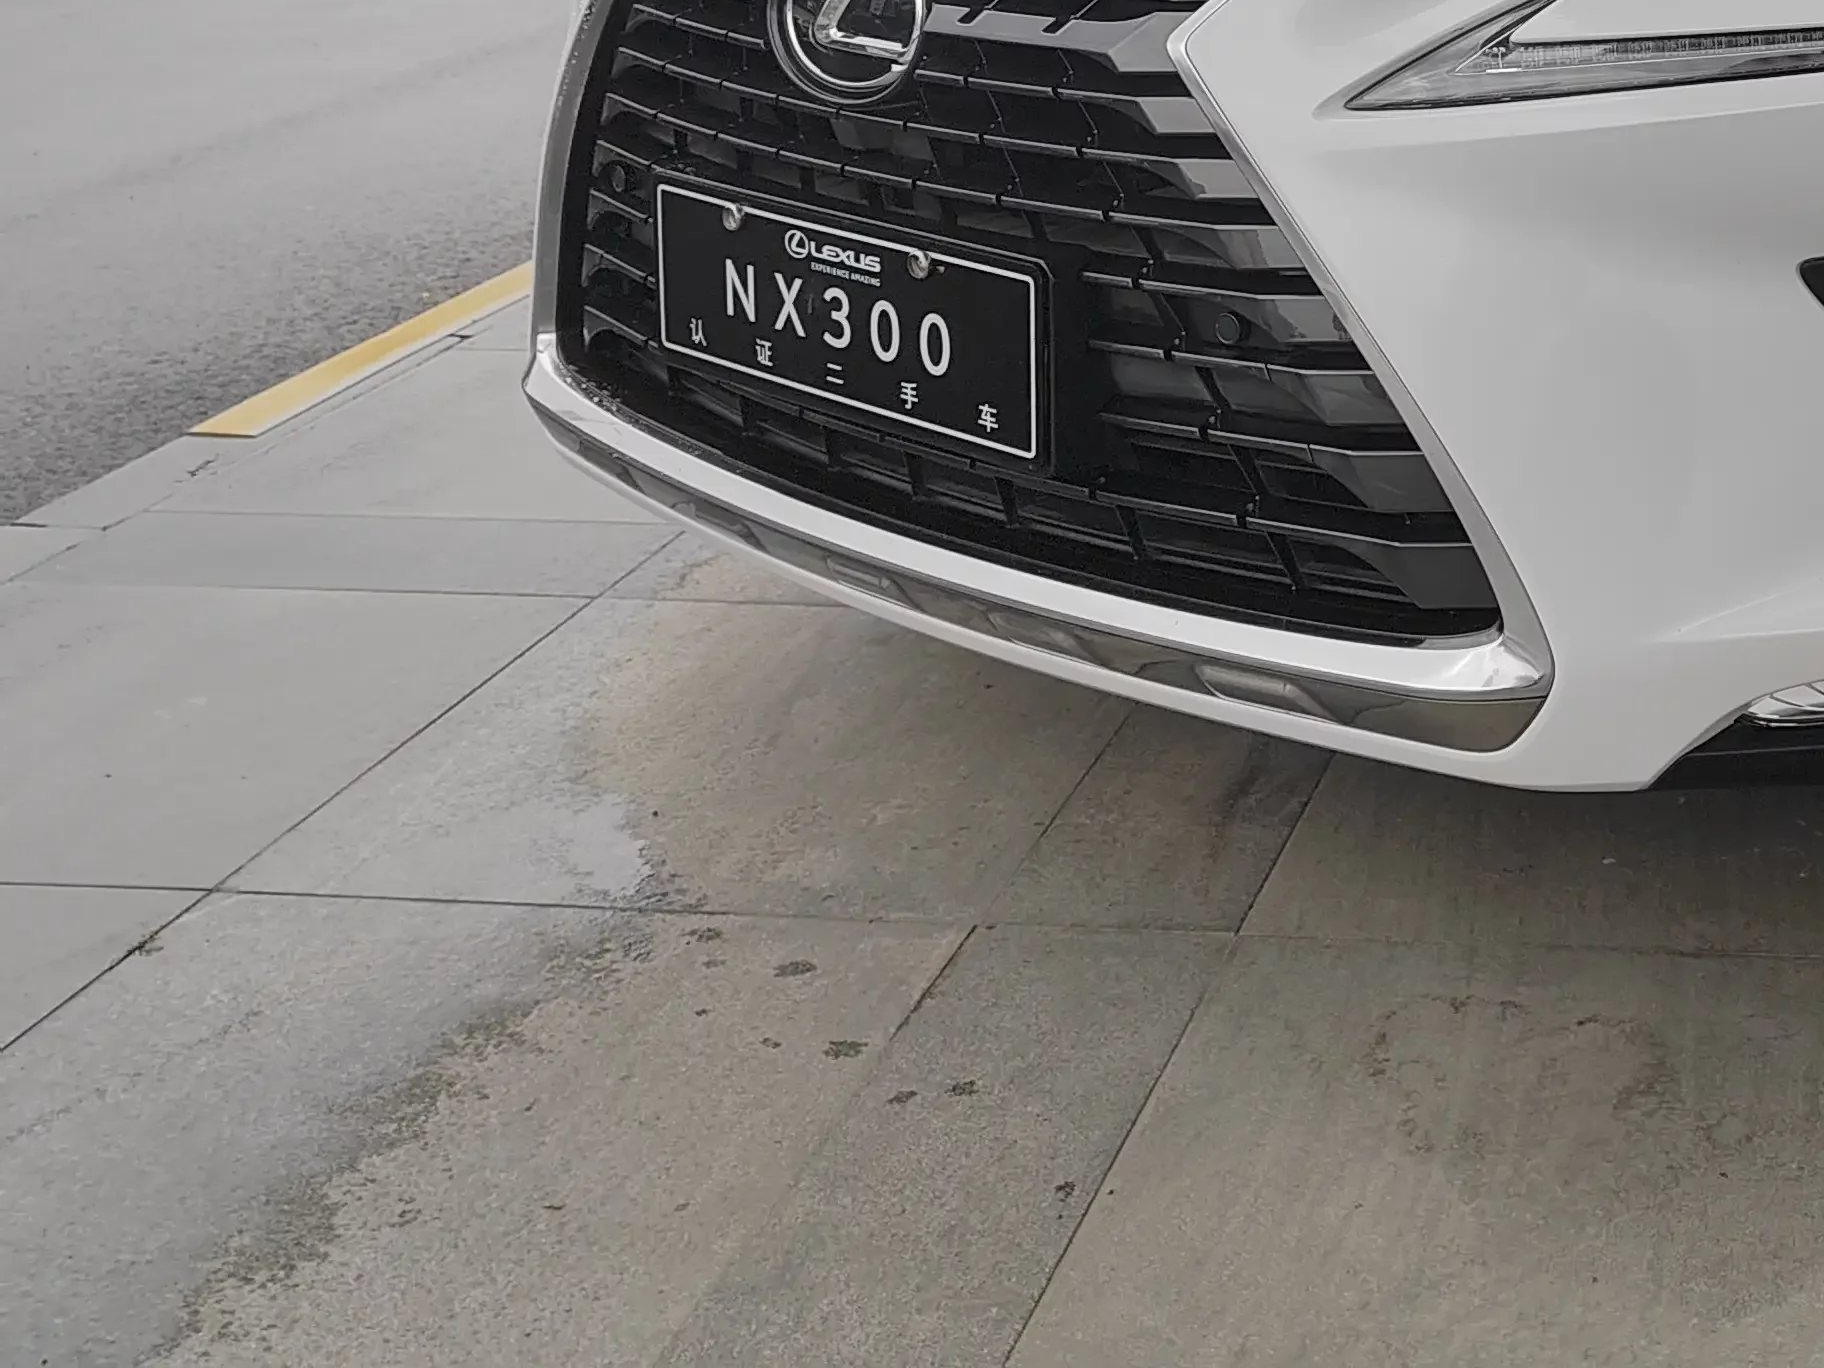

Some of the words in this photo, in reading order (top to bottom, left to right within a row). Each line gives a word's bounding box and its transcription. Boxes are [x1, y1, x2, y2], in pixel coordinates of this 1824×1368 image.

[810, 240, 882, 273] LEXUS
[810, 261, 849, 280] EXPERIENCE
[850, 272, 881, 287] AMAZING
[724, 258, 950, 377] NX300
[689, 317, 999, 433] 认证二手车
